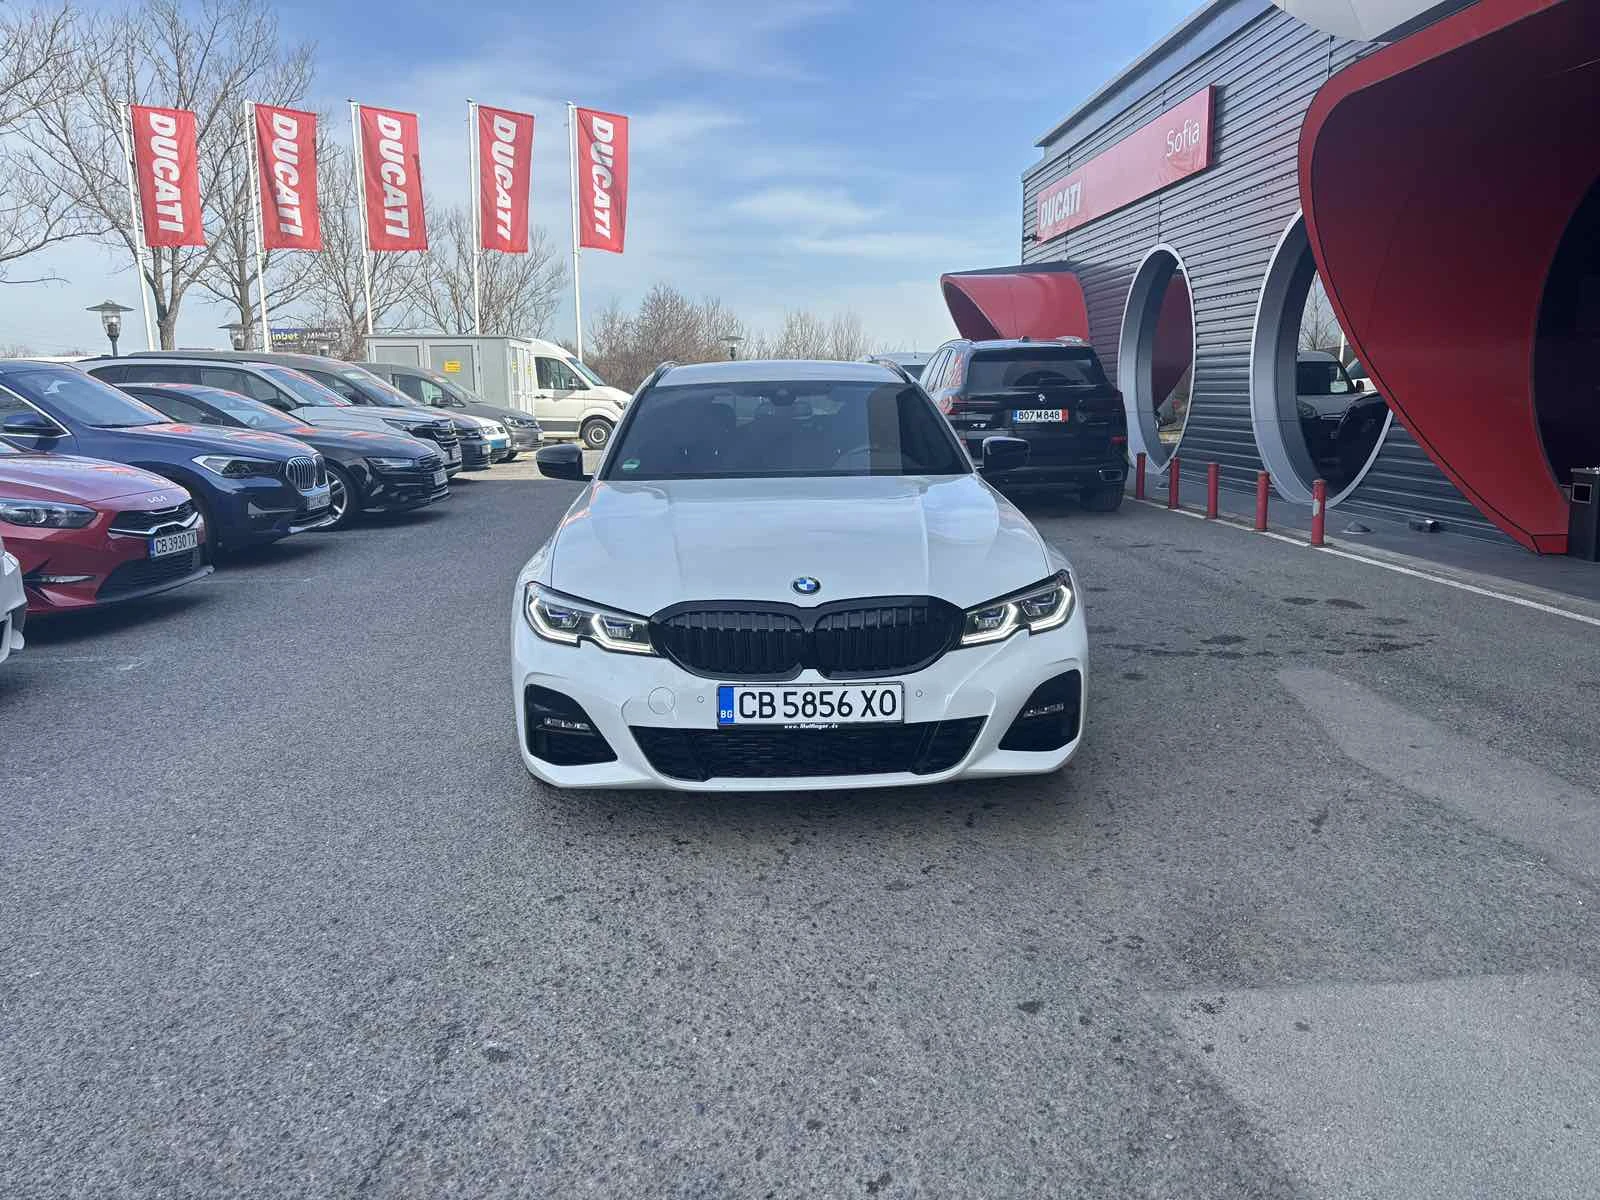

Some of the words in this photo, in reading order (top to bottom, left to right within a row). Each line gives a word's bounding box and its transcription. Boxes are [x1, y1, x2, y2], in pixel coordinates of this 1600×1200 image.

[1166, 119, 1200, 157] Sofia
[149, 112, 184, 233] DUCATI
[272, 112, 304, 237] DUCATI
[376, 113, 410, 239] DUCATI
[491, 114, 516, 240] DUCATI
[591, 115, 615, 239] DUCATI
[1039, 180, 1082, 229] DUCATI
[1018, 410, 1035, 420] 807
[1036, 410, 1043, 420] M
[1044, 410, 1060, 420] 848
[155, 539, 168, 554] CB
[168, 534, 187, 551] 3930
[187, 531, 197, 545] TX
[720, 711, 733, 719] BG
[739, 691, 776, 719] CB
[783, 690, 853, 718] 5856
[860, 689, 897, 717] XO
